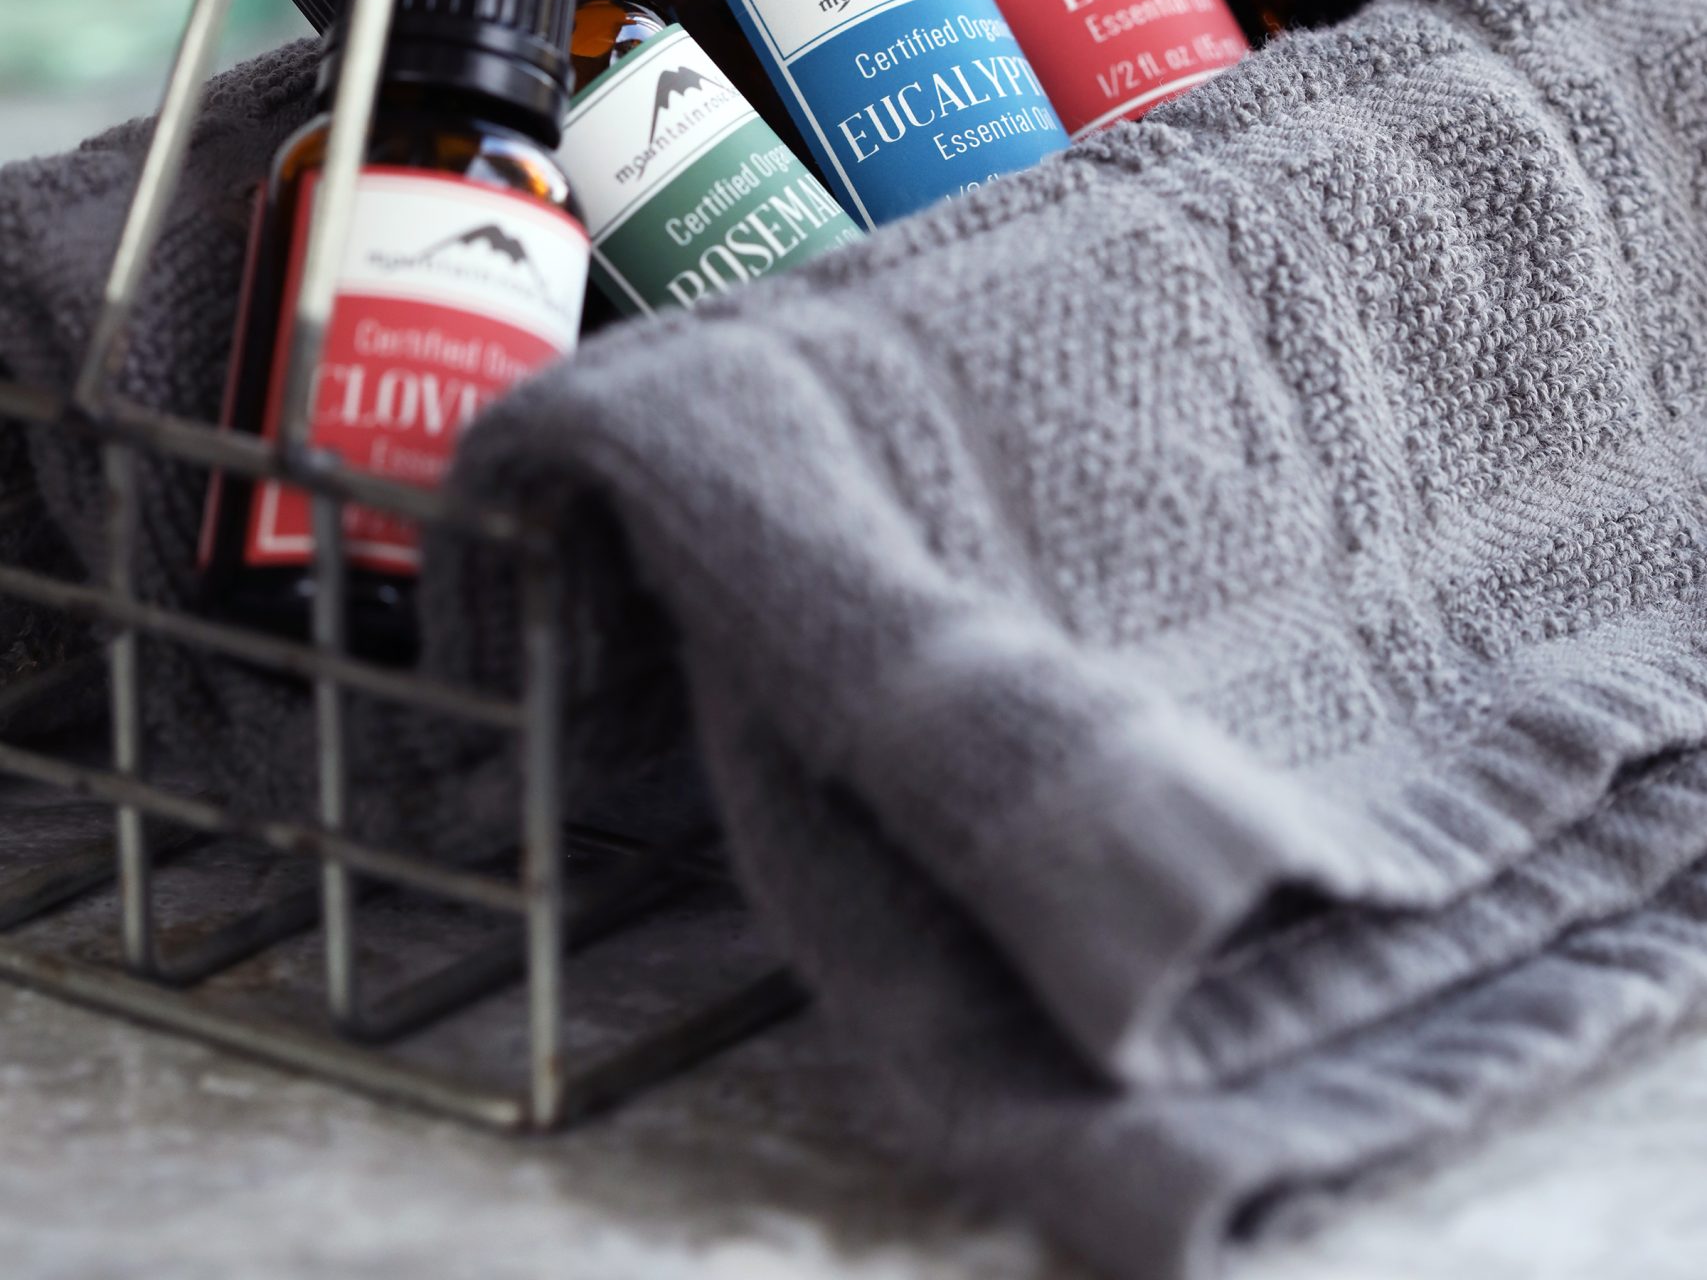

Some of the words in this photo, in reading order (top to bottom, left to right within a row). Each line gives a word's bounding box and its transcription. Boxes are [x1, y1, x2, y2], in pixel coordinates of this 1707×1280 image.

[855, 18, 959, 79] Certified
[615, 106, 708, 185] mountain
[933, 108, 1037, 161] Essential
[665, 162, 761, 246] Certified
